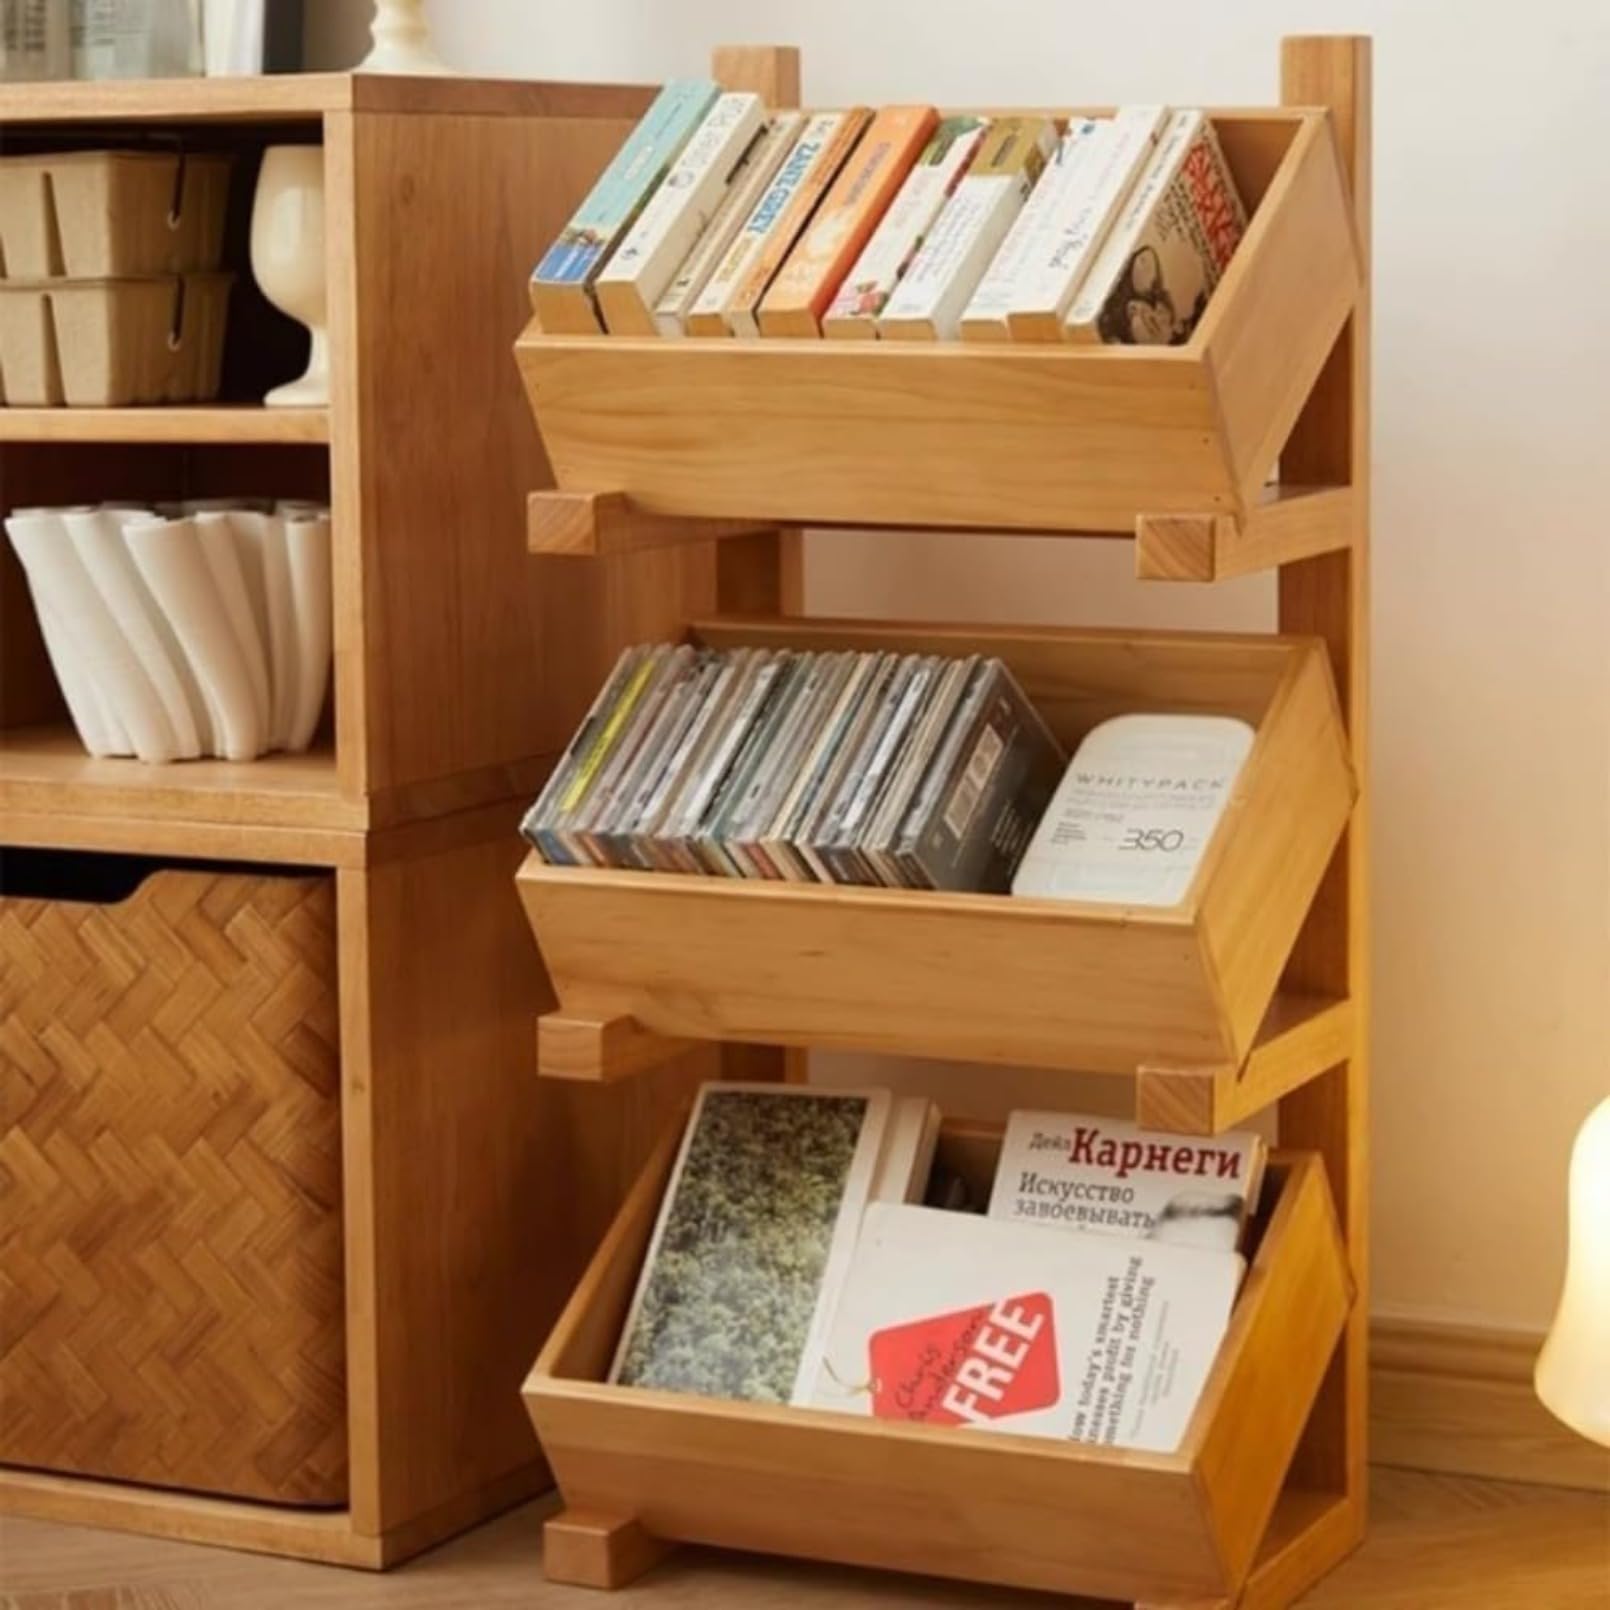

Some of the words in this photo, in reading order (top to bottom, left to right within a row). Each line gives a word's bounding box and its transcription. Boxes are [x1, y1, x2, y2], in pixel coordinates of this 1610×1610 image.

[1116, 827, 1185, 852] 350
[1068, 1126, 1243, 1180] Карнеги
[1018, 1171, 1135, 1204] Искусство
[1012, 1197, 1158, 1231] завоевывать
[1121, 1255, 1144, 1308] giving
[1077, 1349, 1102, 1407] today's
[1095, 1275, 1119, 1344] smartest
[1111, 1312, 1131, 1333] by
[1119, 1345, 1137, 1369] for
[1128, 1275, 1157, 1341] nothing
[942, 1298, 1045, 1424] FREE
[1101, 1338, 1123, 1383] profit
